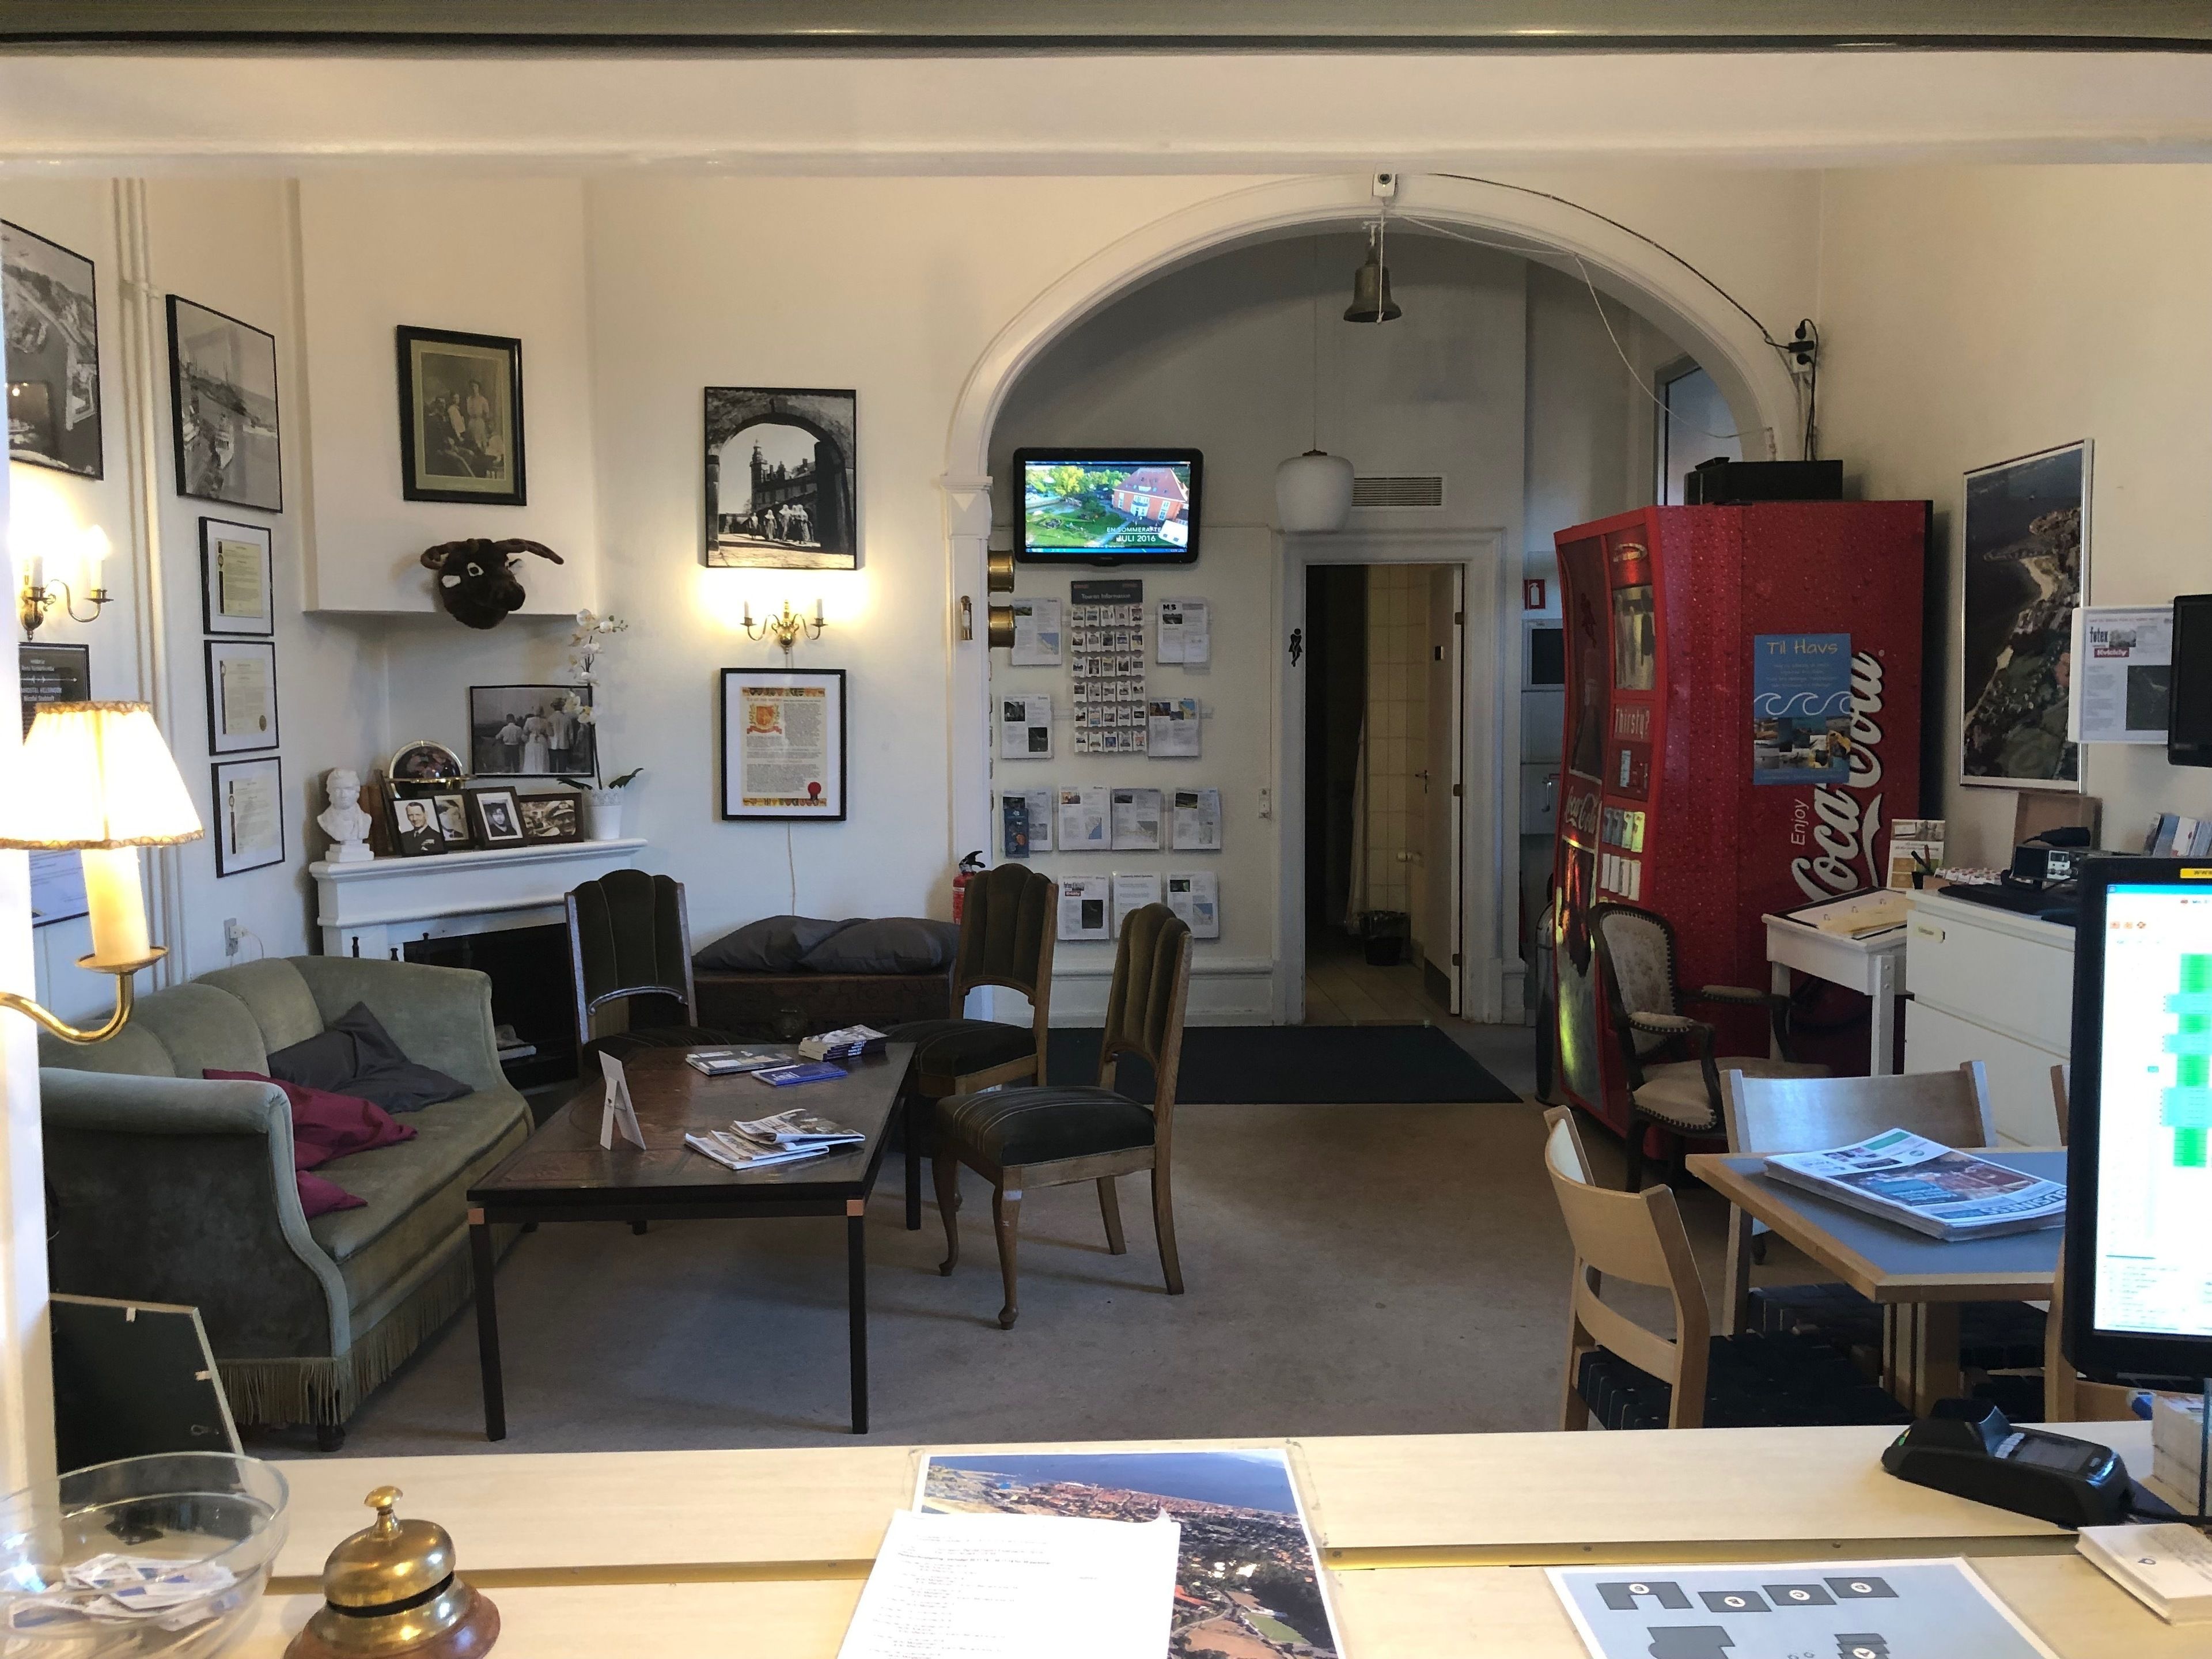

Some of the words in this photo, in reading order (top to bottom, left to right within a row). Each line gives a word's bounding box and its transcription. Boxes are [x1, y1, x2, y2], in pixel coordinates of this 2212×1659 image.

[1767, 640, 1786, 655] Til
[1794, 638, 1838, 654] Havs
[1615, 708, 1650, 740] Thirsty?
[1791, 798, 1809, 846] Enjoy
